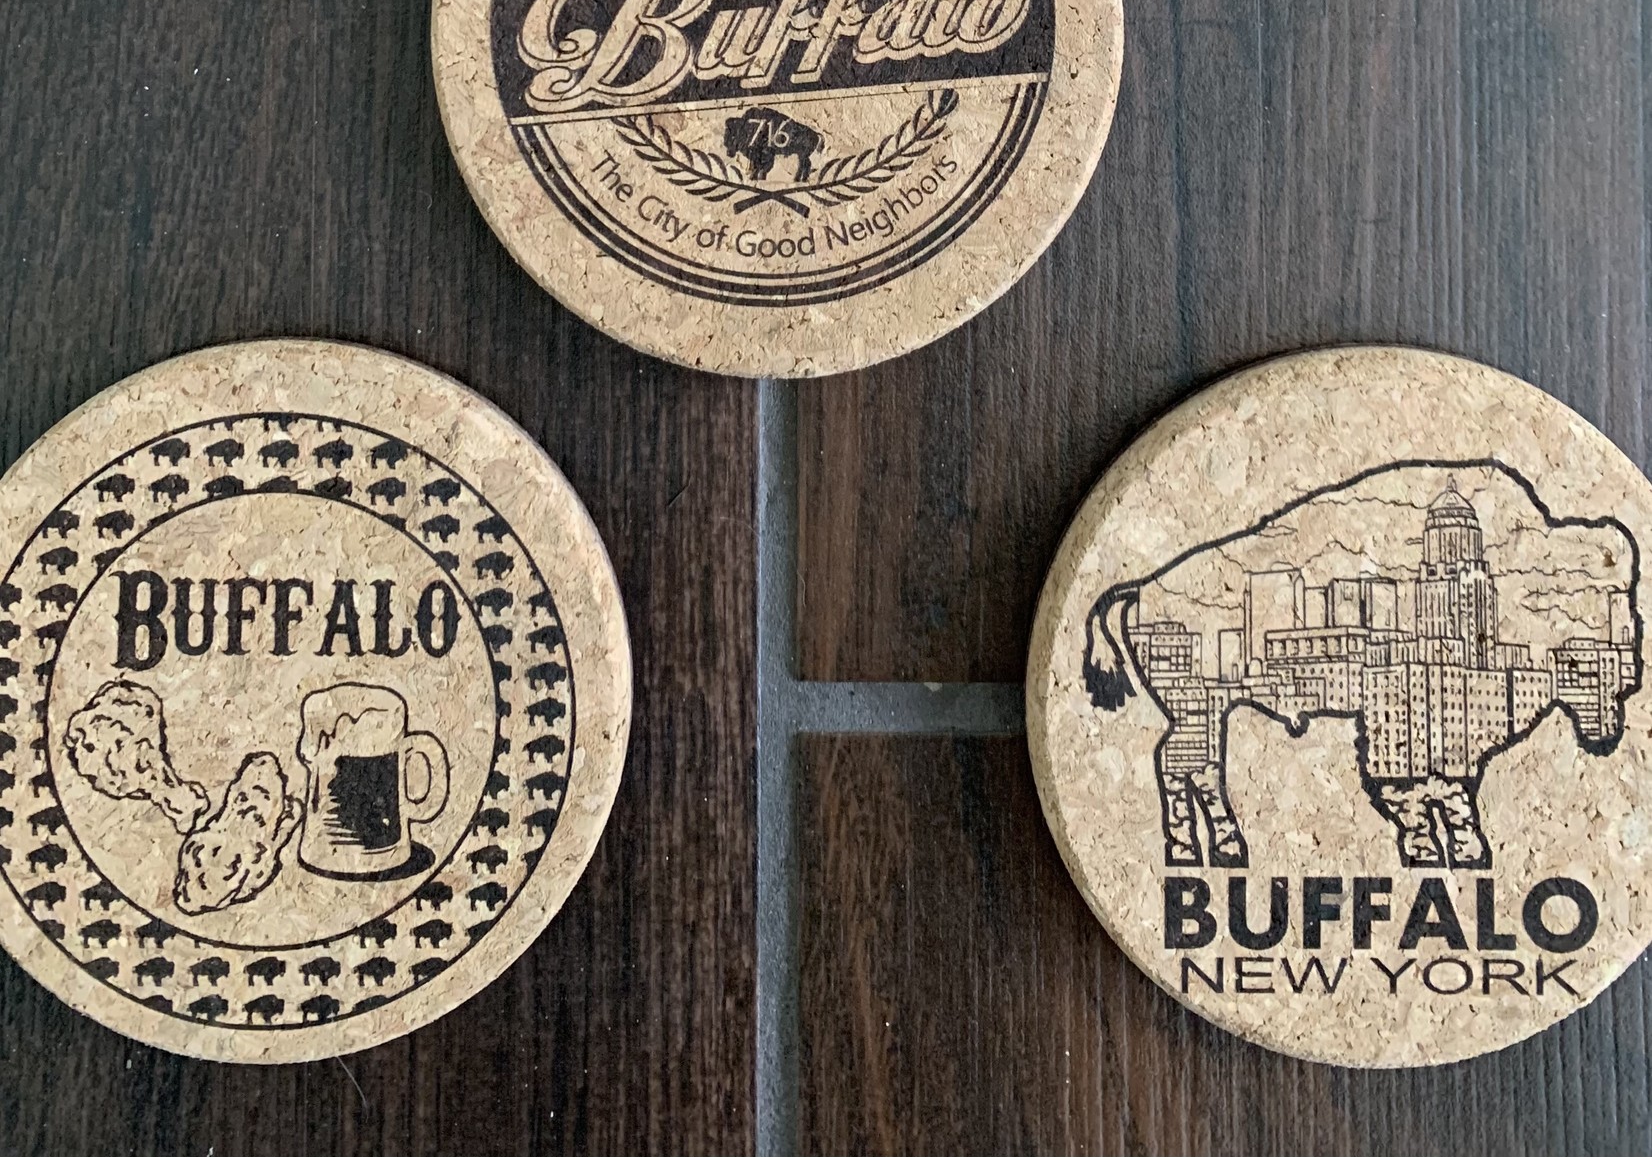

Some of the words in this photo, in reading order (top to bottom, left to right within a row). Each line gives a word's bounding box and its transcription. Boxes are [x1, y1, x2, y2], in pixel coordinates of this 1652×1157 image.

[747, 118, 791, 149] 716
[590, 150, 635, 203] The
[637, 194, 691, 243] City
[695, 224, 728, 250] of
[735, 230, 816, 259] Good
[824, 152, 960, 252] Neighbors
[112, 570, 462, 671] BUFFALO
[1163, 876, 1600, 953] BUFFALO
[1180, 957, 1348, 994] NEW
[1368, 958, 1579, 995] YORK
